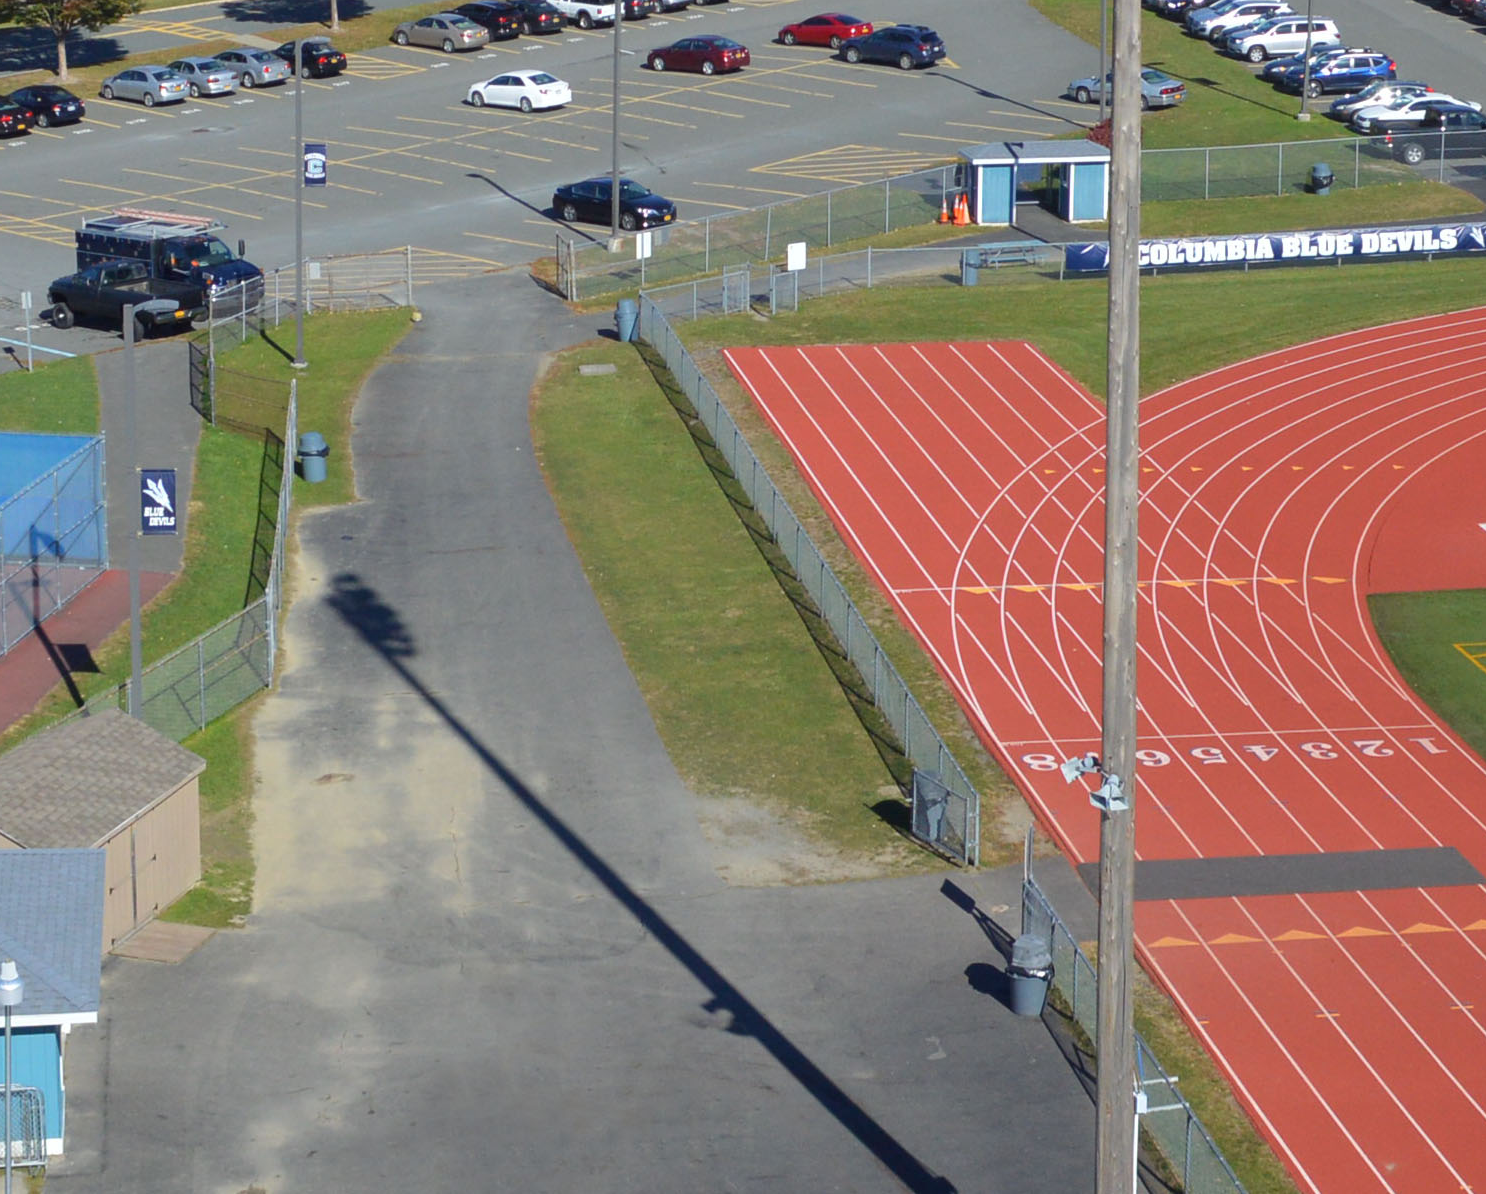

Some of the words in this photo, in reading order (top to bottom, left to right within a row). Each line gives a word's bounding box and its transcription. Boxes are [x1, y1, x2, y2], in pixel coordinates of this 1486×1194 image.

[1138, 237, 1275, 266] COLUMBIA
[1282, 232, 1354, 258] BLUE
[1360, 228, 1458, 254] DEVILS
[144, 507, 165, 516] BLUE
[149, 517, 176, 526] DEVILS
[1243, 744, 1280, 762] 4
[1300, 742, 1339, 760] 3
[1352, 739, 1395, 757] 2
[1408, 737, 1448, 755] 1
[1022, 753, 1059, 771] 8
[1135, 749, 1171, 767] 6
[1190, 746, 1228, 765] 5
